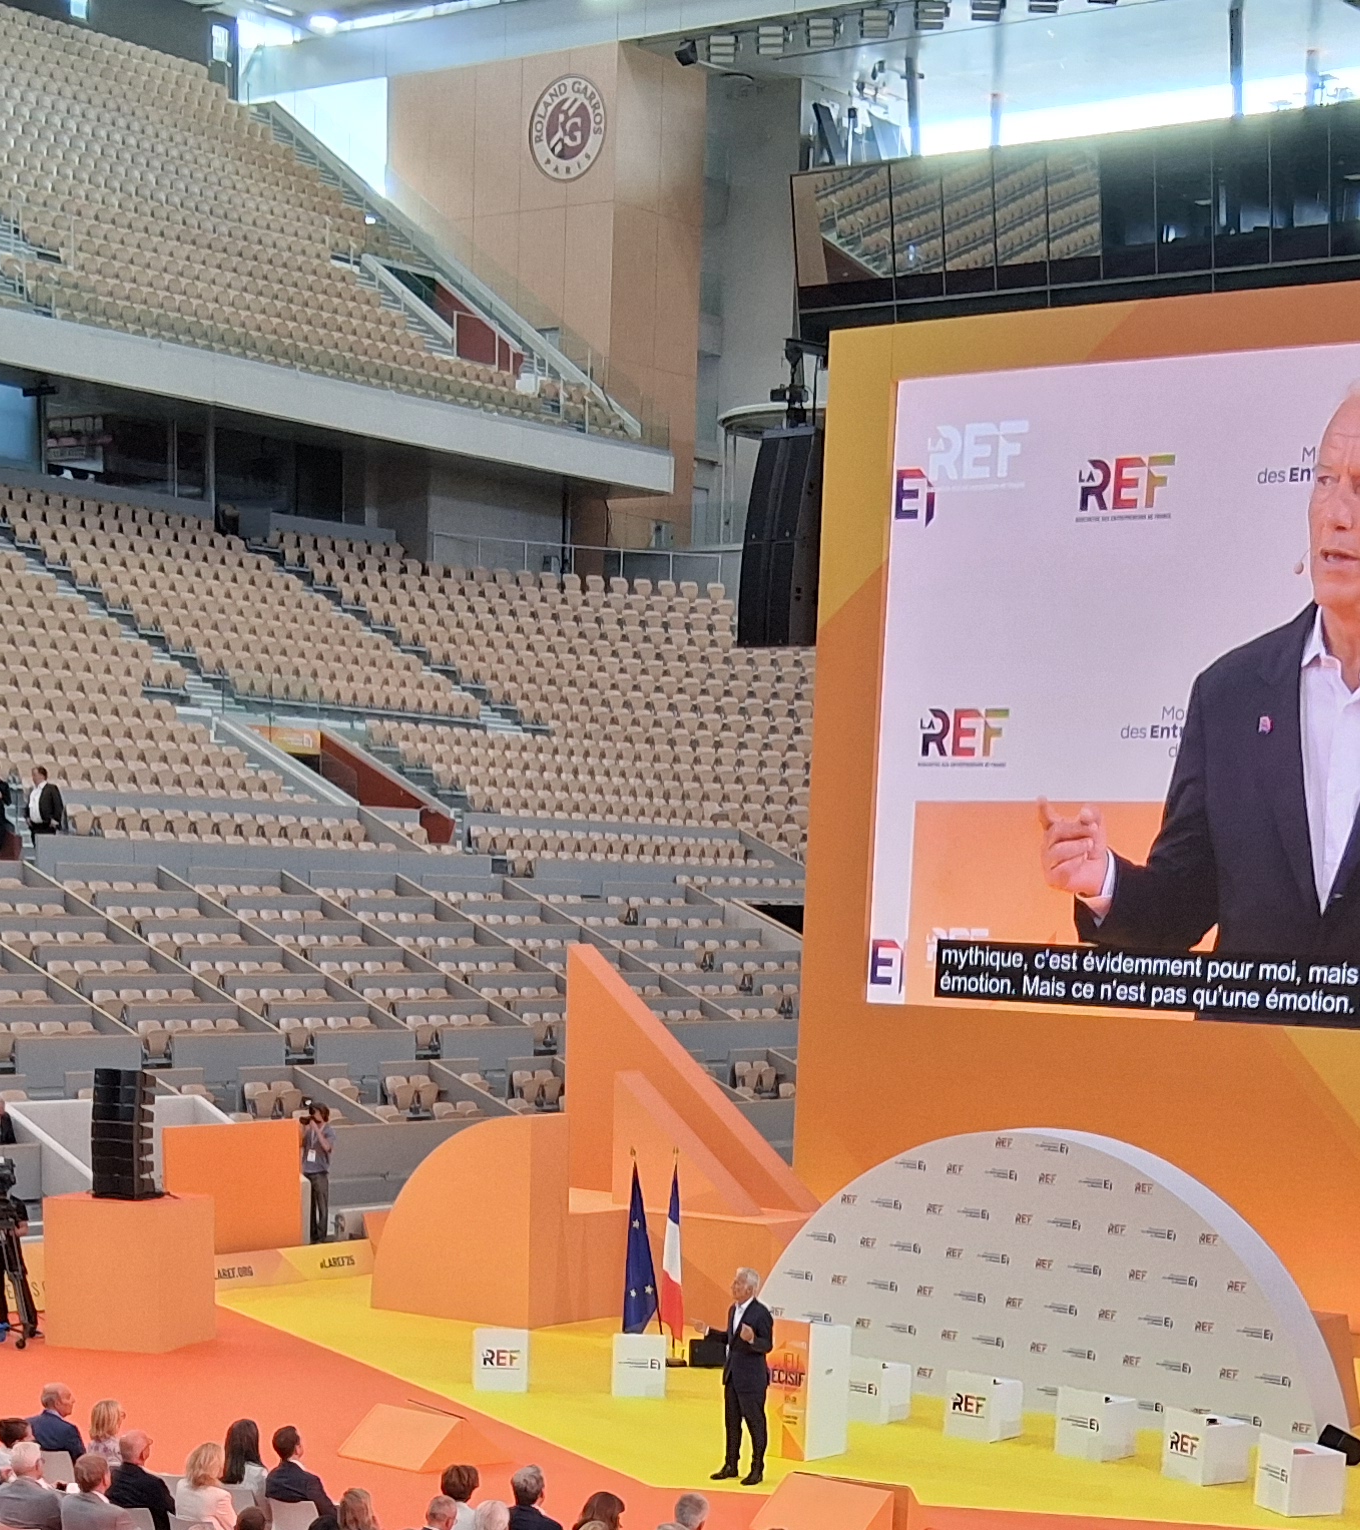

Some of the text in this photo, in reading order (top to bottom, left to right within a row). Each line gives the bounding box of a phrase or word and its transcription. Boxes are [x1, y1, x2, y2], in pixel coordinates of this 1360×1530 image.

[535, 80, 603, 144] ROLAND GARROS
[543, 152, 592, 176] PARIS
[928, 420, 1030, 481] REF
[1078, 453, 1177, 512] REF
[1257, 466, 1286, 485] des
[920, 708, 1010, 757] REF
[1120, 724, 1147, 739] des
[941, 946, 1029, 972] mythique,
[1034, 949, 1078, 972] c'est
[1082, 949, 1202, 977] évidemment
[1206, 960, 1255, 983] pour
[1258, 959, 1302, 986] moi,
[1308, 961, 1360, 985] mais
[940, 970, 1017, 996] émotion.
[1022, 974, 1066, 998] Mais
[1071, 981, 1095, 999] ce
[1100, 979, 1147, 1003] n'est
[1151, 985, 1187, 1007] pas
[1192, 984, 1260, 1011] qu'une
[1265, 987, 1355, 1014] émotion.
[215, 1265, 254, 1281] AREF.ORG
[482, 1349, 521, 1368] REF
[951, 1392, 987, 1415] REF
[1169, 1431, 1200, 1457] REF
